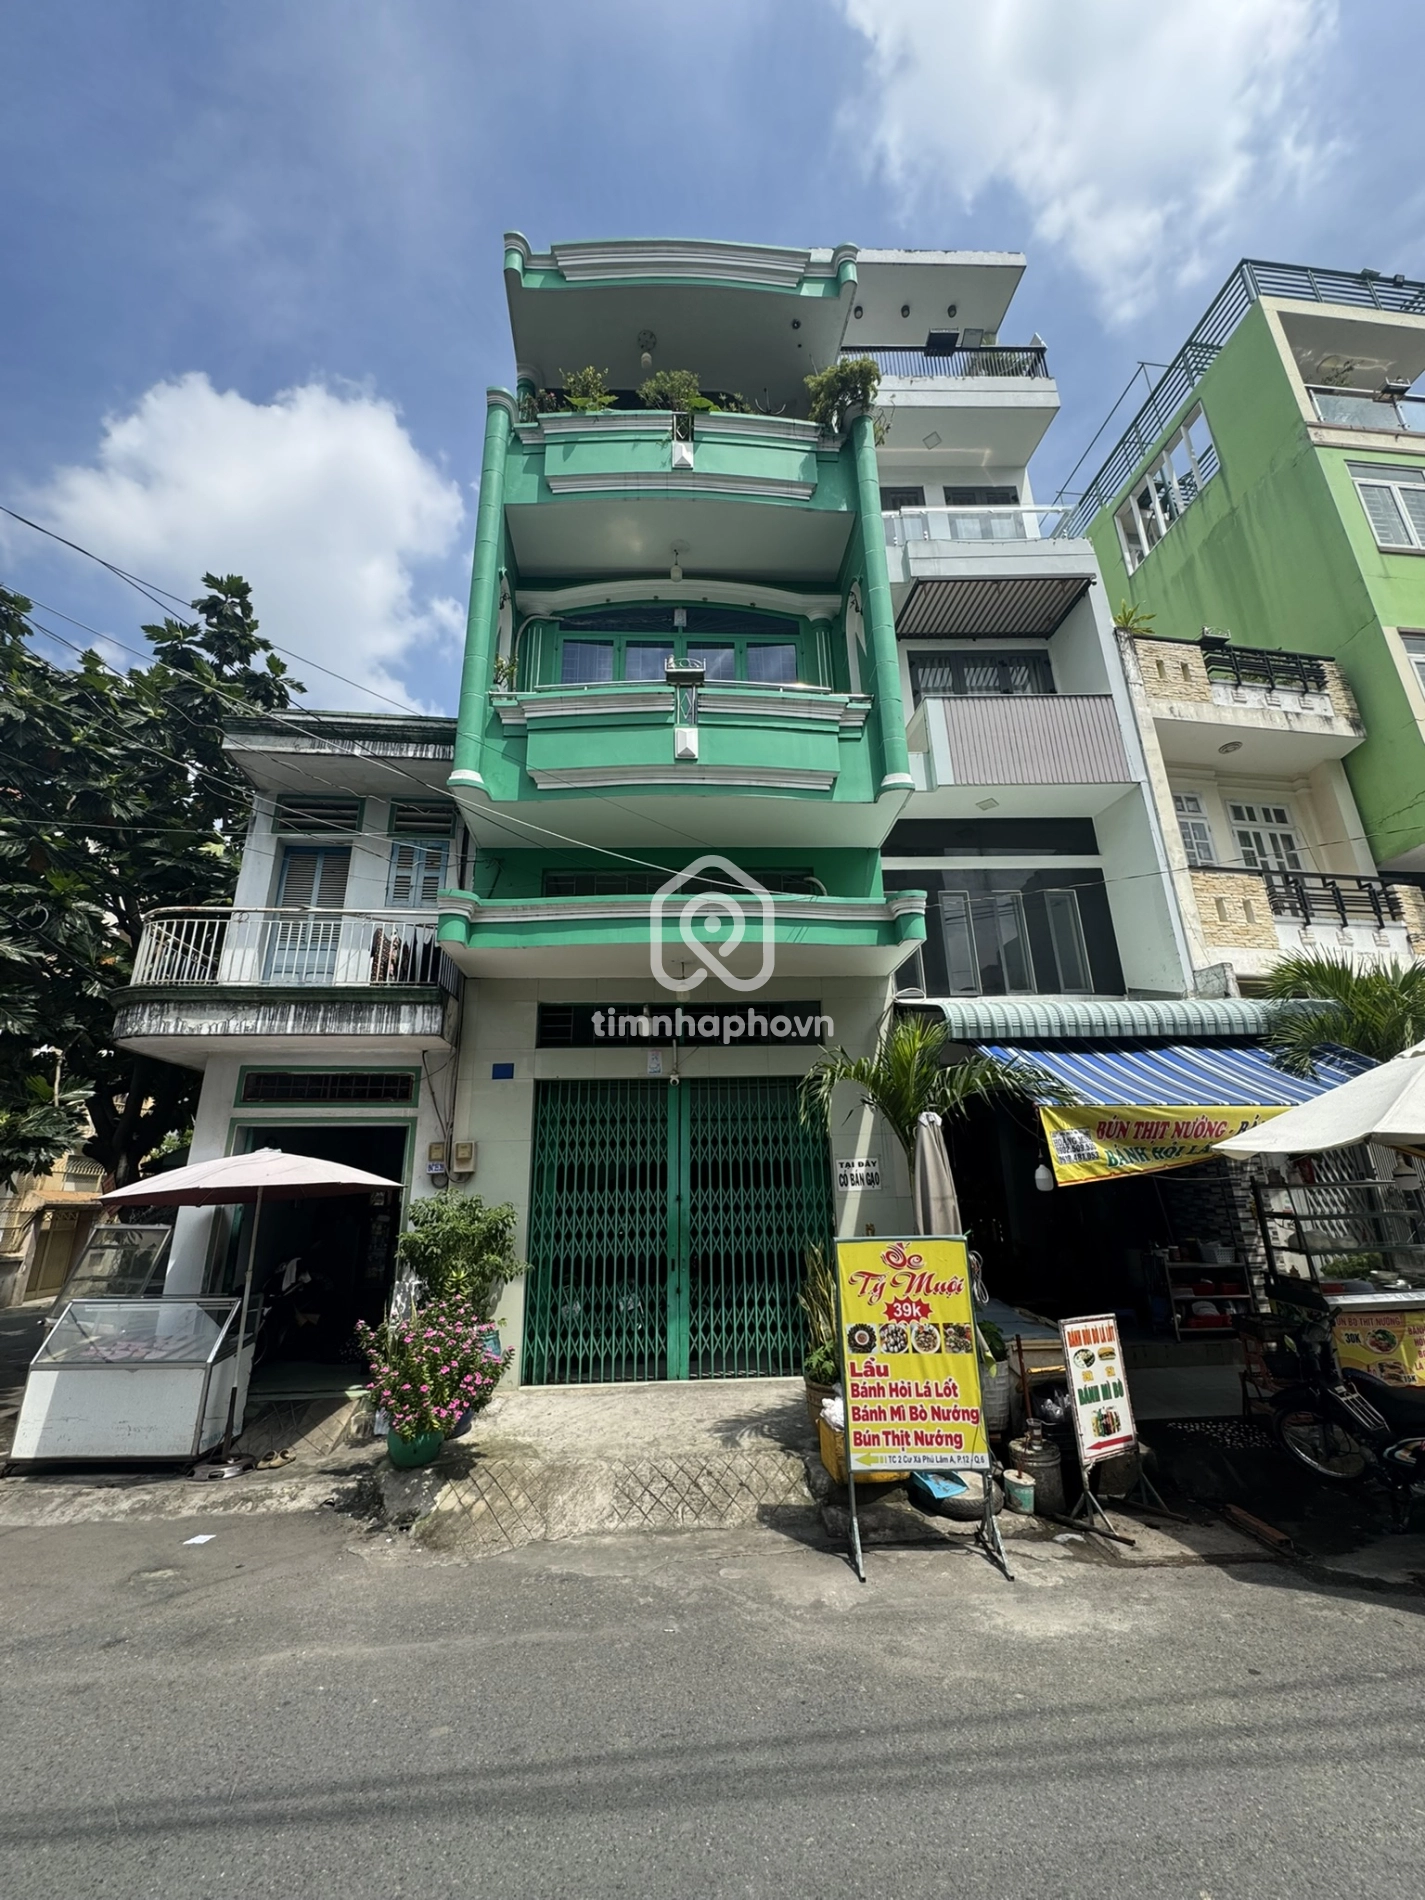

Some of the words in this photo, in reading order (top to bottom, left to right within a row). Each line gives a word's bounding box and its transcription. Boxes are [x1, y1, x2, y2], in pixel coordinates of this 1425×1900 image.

[1096, 1115, 1130, 1139] BÚN
[1133, 1121, 1170, 1143] THỊT
[1171, 1115, 1227, 1139] NƯỚNG
[1105, 1144, 1150, 1167] BÁNH
[839, 1170, 849, 1187] CÓ
[850, 1169, 865, 1187] BÁN
[866, 1172, 880, 1188] GẠO
[890, 1271, 964, 1299] Muội
[893, 1303, 922, 1318] 39k
[850, 1381, 886, 1398] Bánh
[914, 1381, 932, 1398] Lá
[934, 1378, 959, 1398] Lốt
[851, 1405, 887, 1422] Bánh
[890, 1404, 905, 1422] Mì
[908, 1404, 928, 1422] Bò
[930, 1404, 979, 1425] Nướng
[853, 1430, 880, 1447] Bún
[882, 1429, 911, 1451] Thịt
[913, 1429, 963, 1450] Nướng
[888, 1455, 897, 1463] TC
[897, 1455, 902, 1463] 2
